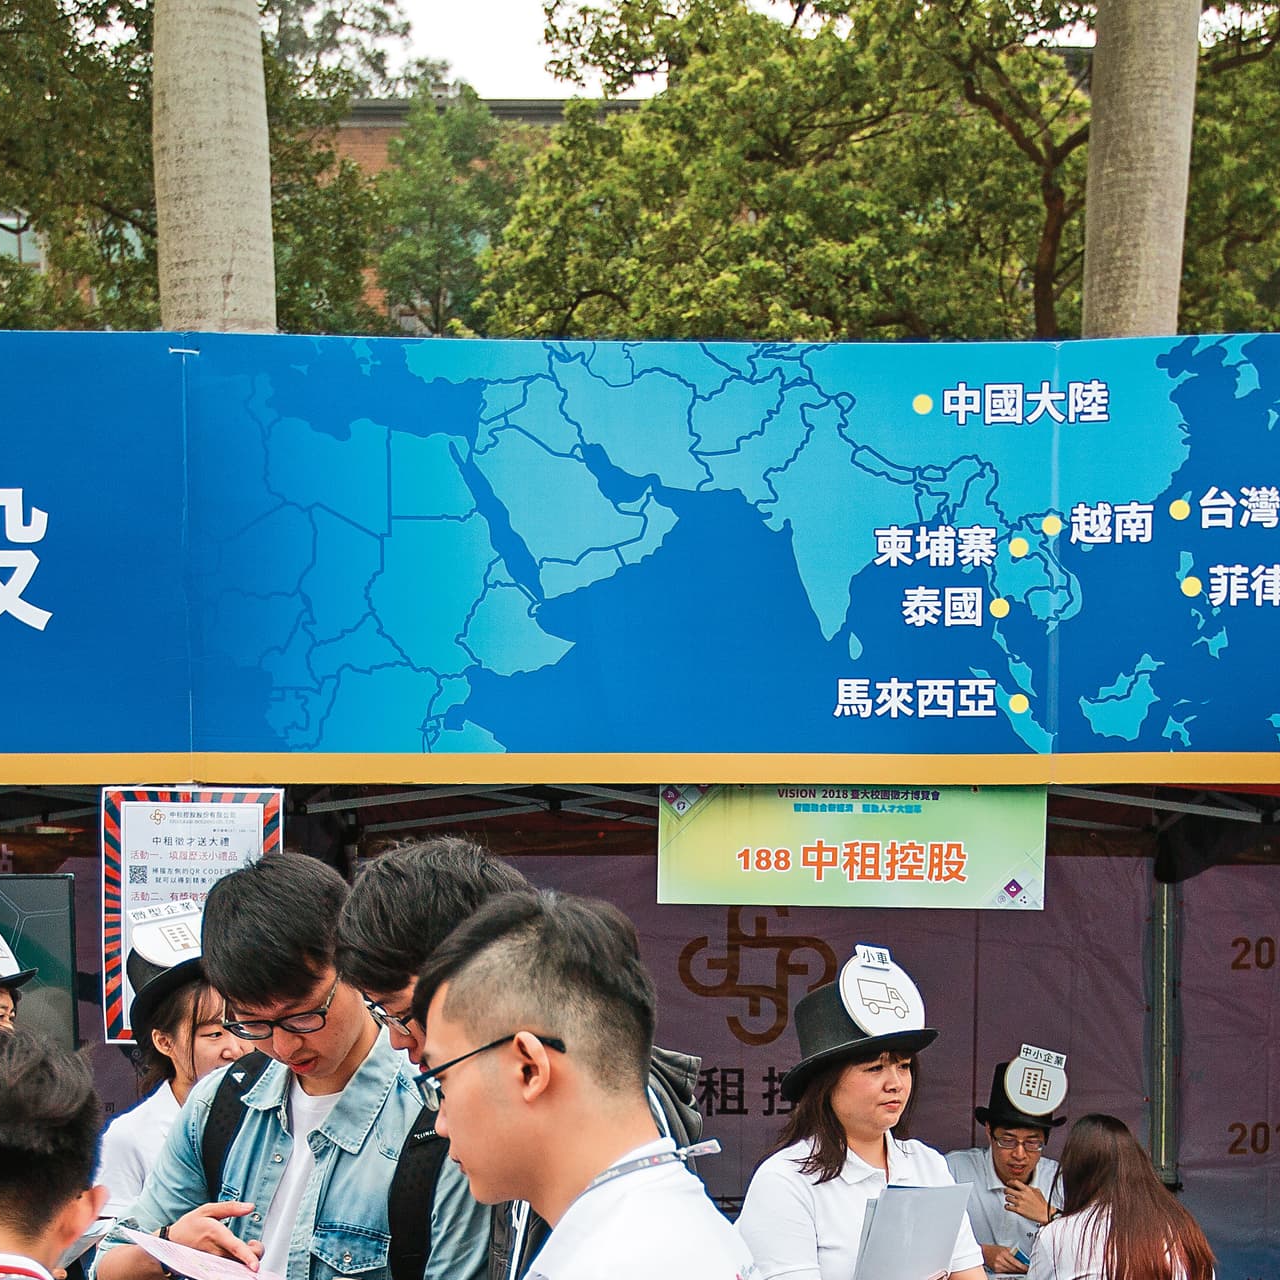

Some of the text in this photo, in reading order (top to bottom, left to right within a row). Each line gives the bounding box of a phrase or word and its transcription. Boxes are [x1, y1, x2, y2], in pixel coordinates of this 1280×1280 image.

[943, 380, 1109, 424] 中國大陸
[1071, 501, 1153, 544] 越南
[1199, 487, 1280, 529] 台灣
[874, 525, 997, 567] 柬埔寨
[902, 586, 984, 627] 泰國
[834, 677, 998, 719] 馬來西亞
[777, 789, 816, 799] VISION
[822, 789, 848, 799] 2018
[736, 838, 968, 883] 188 中租控股
[863, 949, 889, 965] 小車
[1023, 1047, 1064, 1066] 中小企業
